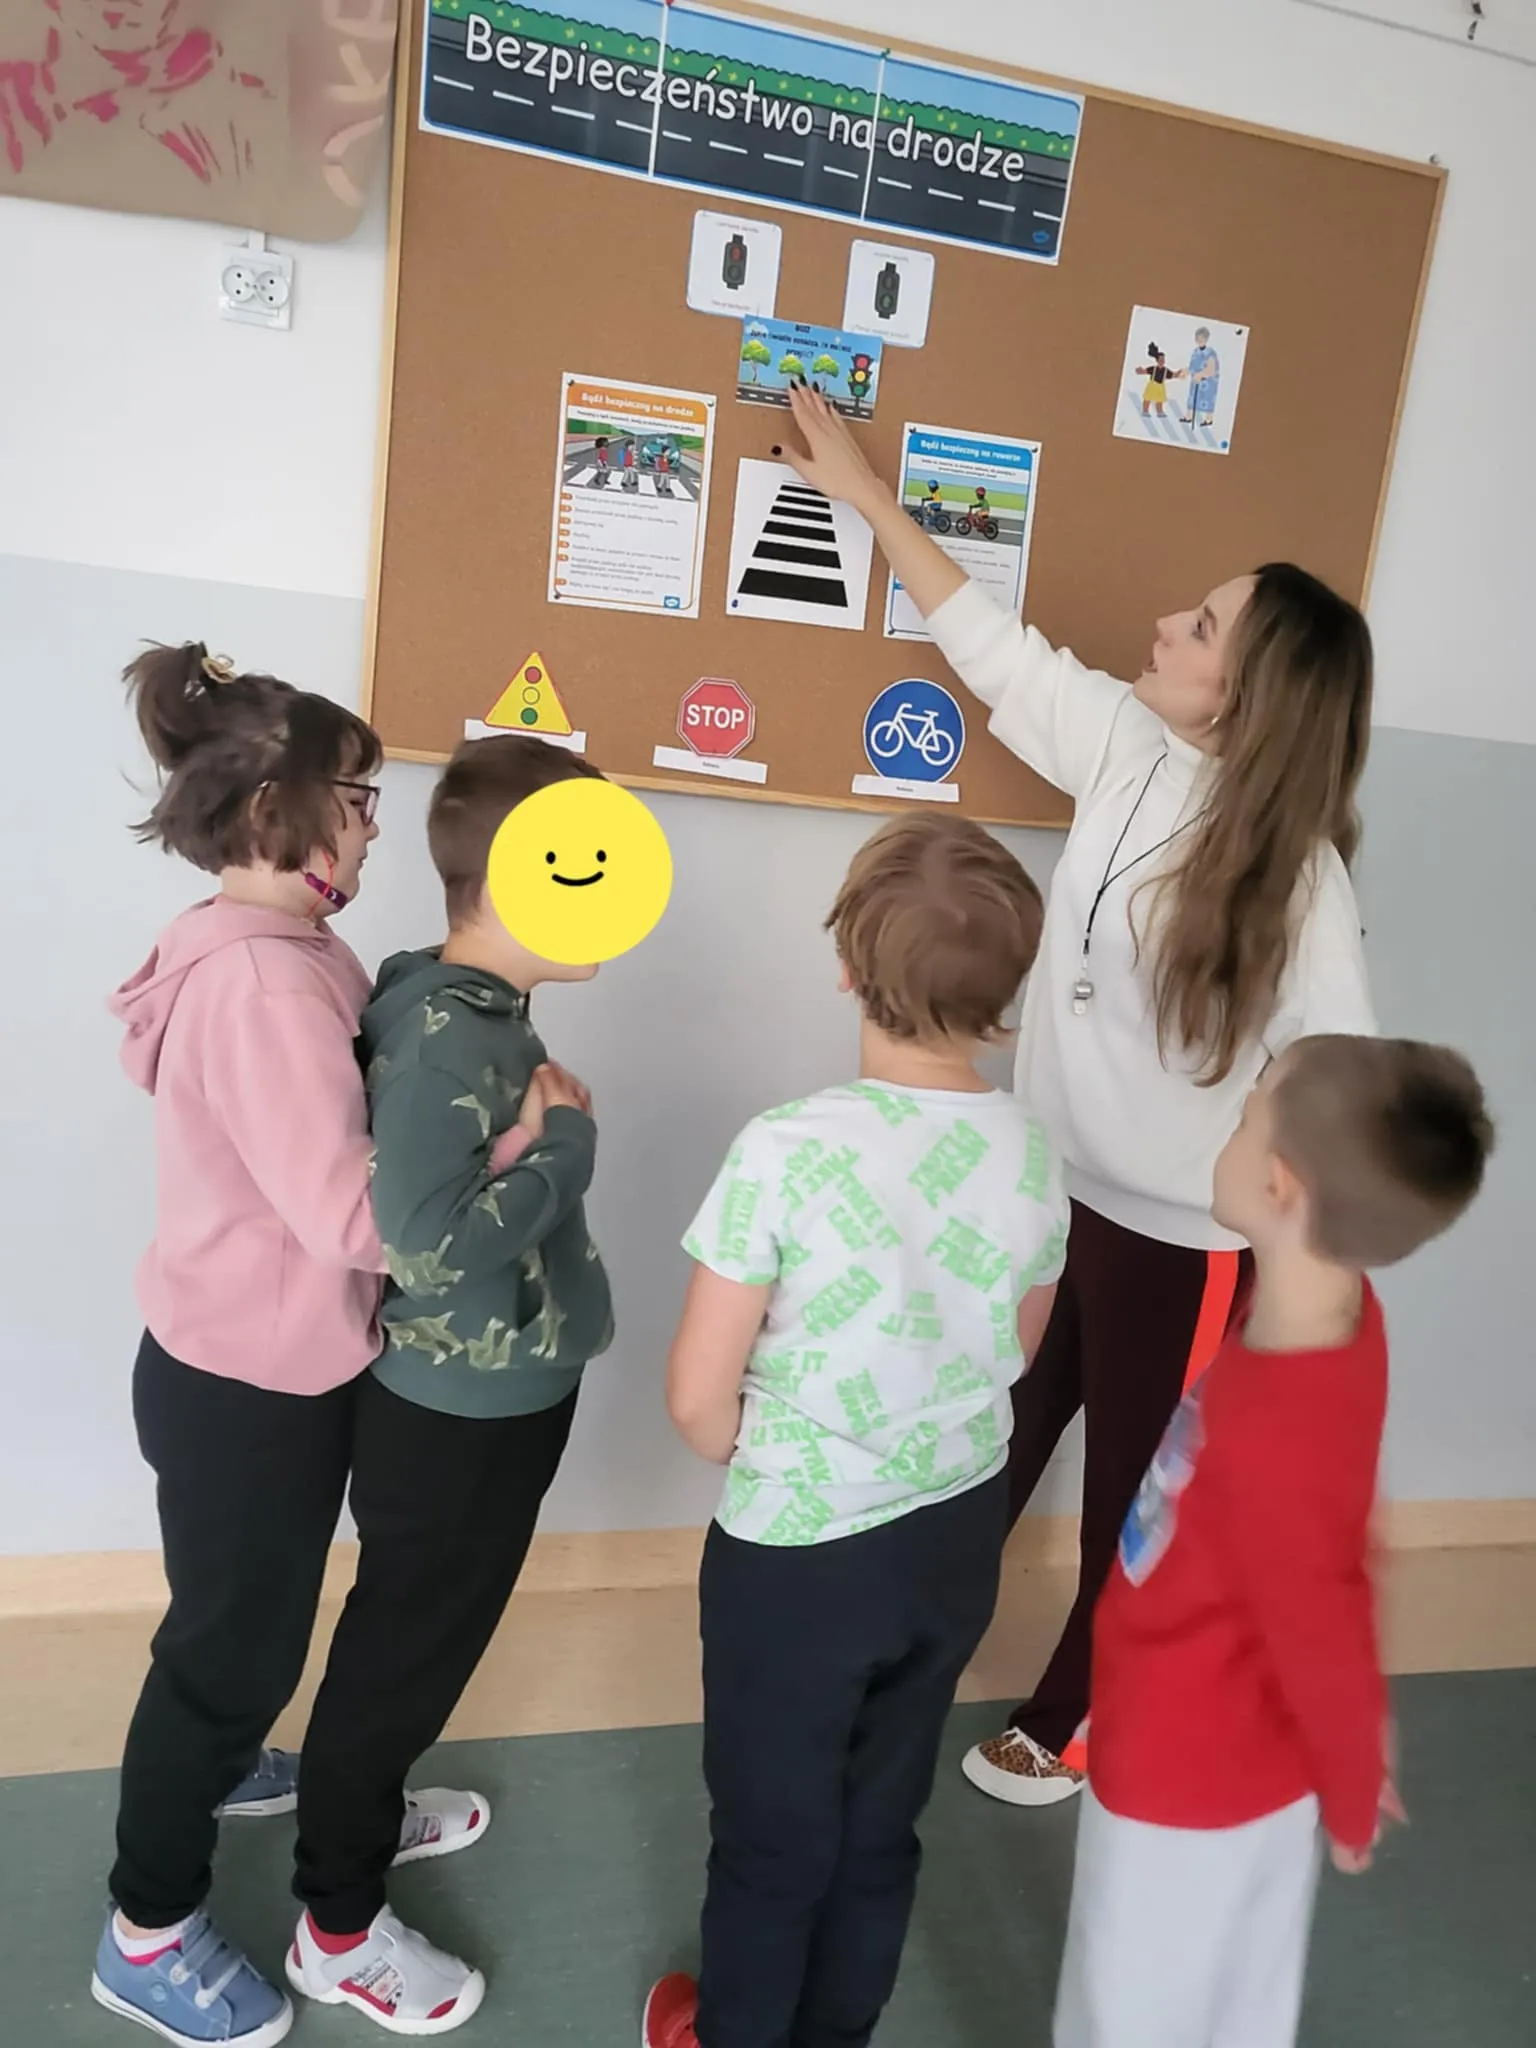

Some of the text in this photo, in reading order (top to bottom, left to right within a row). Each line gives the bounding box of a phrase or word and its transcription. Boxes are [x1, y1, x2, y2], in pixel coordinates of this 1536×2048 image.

[465, 14, 1025, 183] Bezpieczeństwo na drodze
[686, 704, 745, 730] STOP
